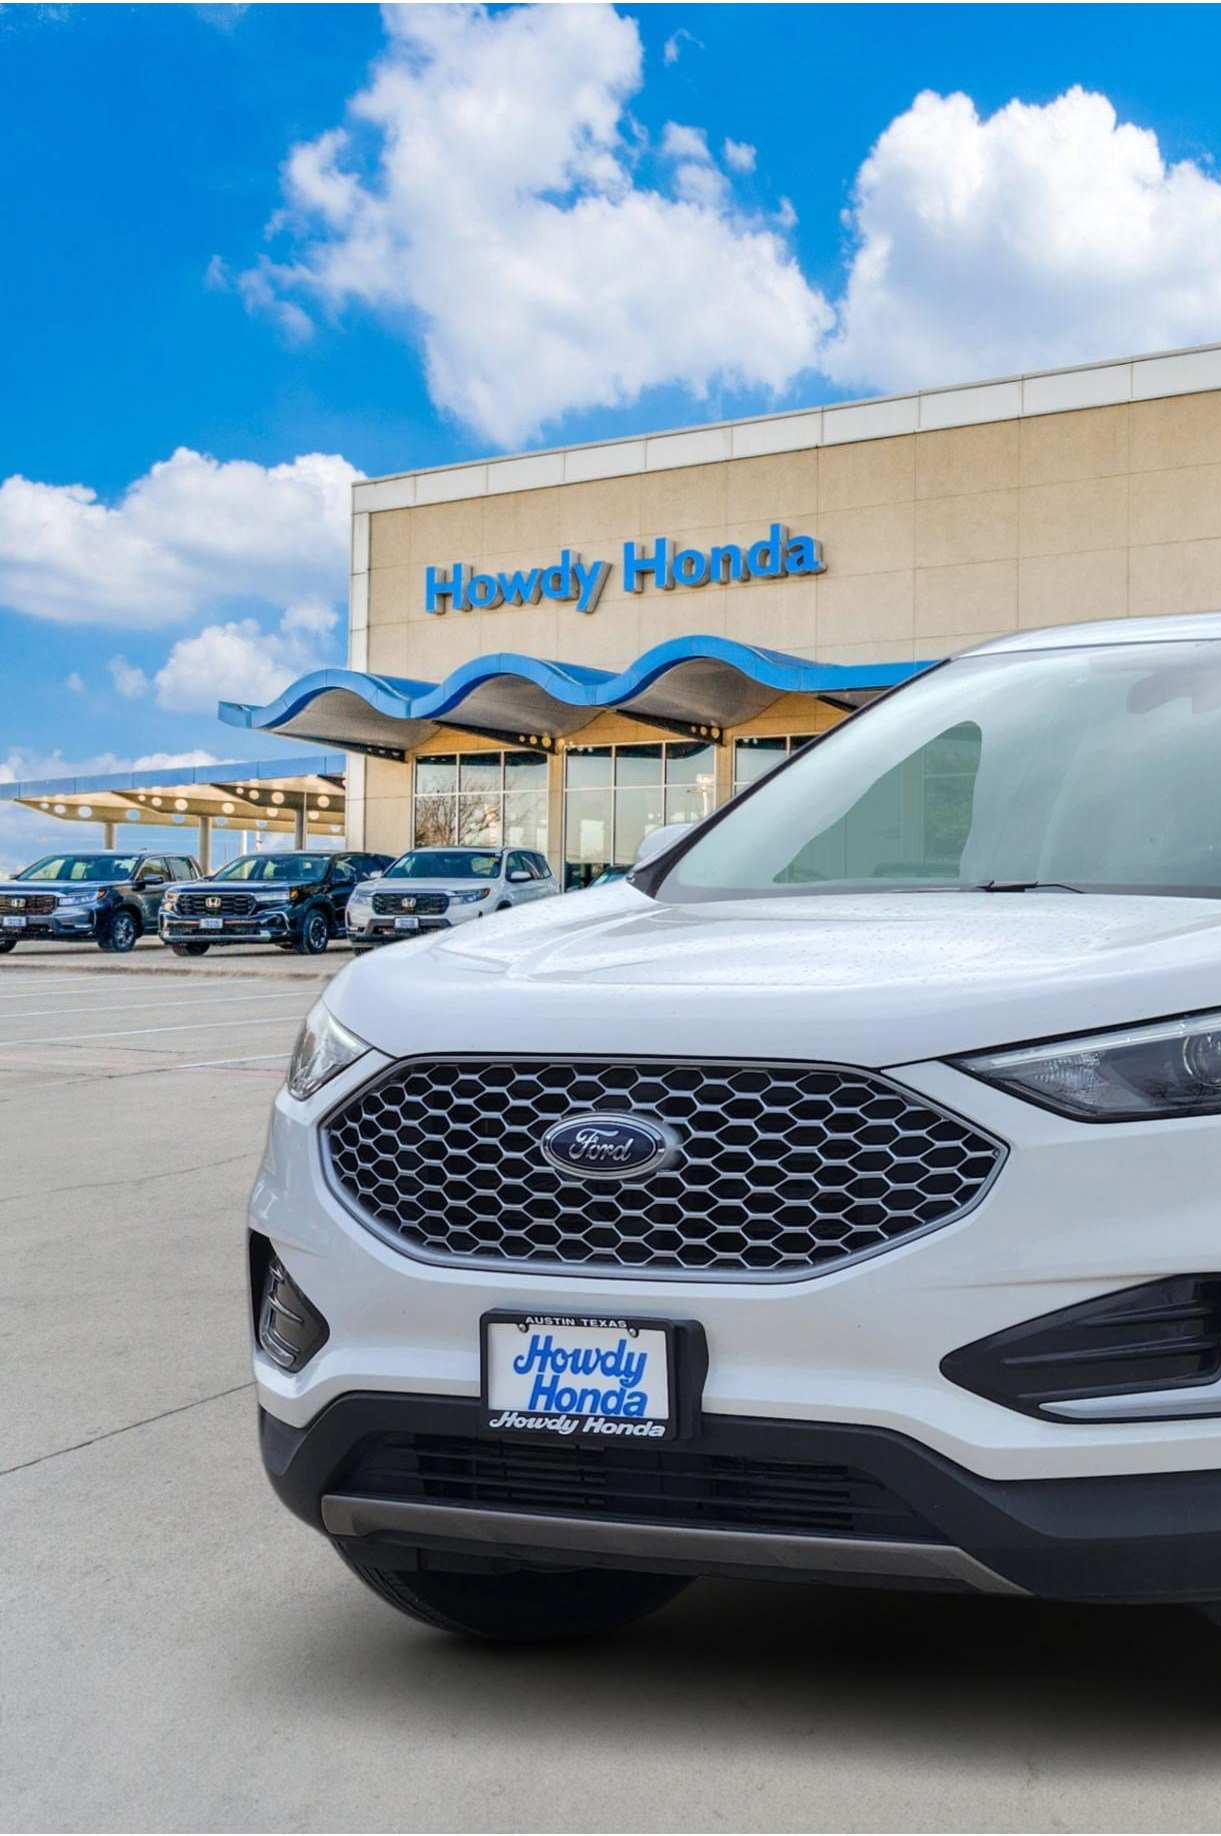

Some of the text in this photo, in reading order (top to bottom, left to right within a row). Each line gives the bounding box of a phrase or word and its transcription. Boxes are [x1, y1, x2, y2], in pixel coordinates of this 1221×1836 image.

[425, 522, 827, 615] Howdy Honda
[568, 1127, 634, 1161] Ford
[525, 1316, 628, 1328] AUSTIN TEXAS
[513, 1334, 648, 1388] Howdy
[528, 1374, 648, 1417] Honda
[489, 1411, 666, 1437] Howdy Honda
